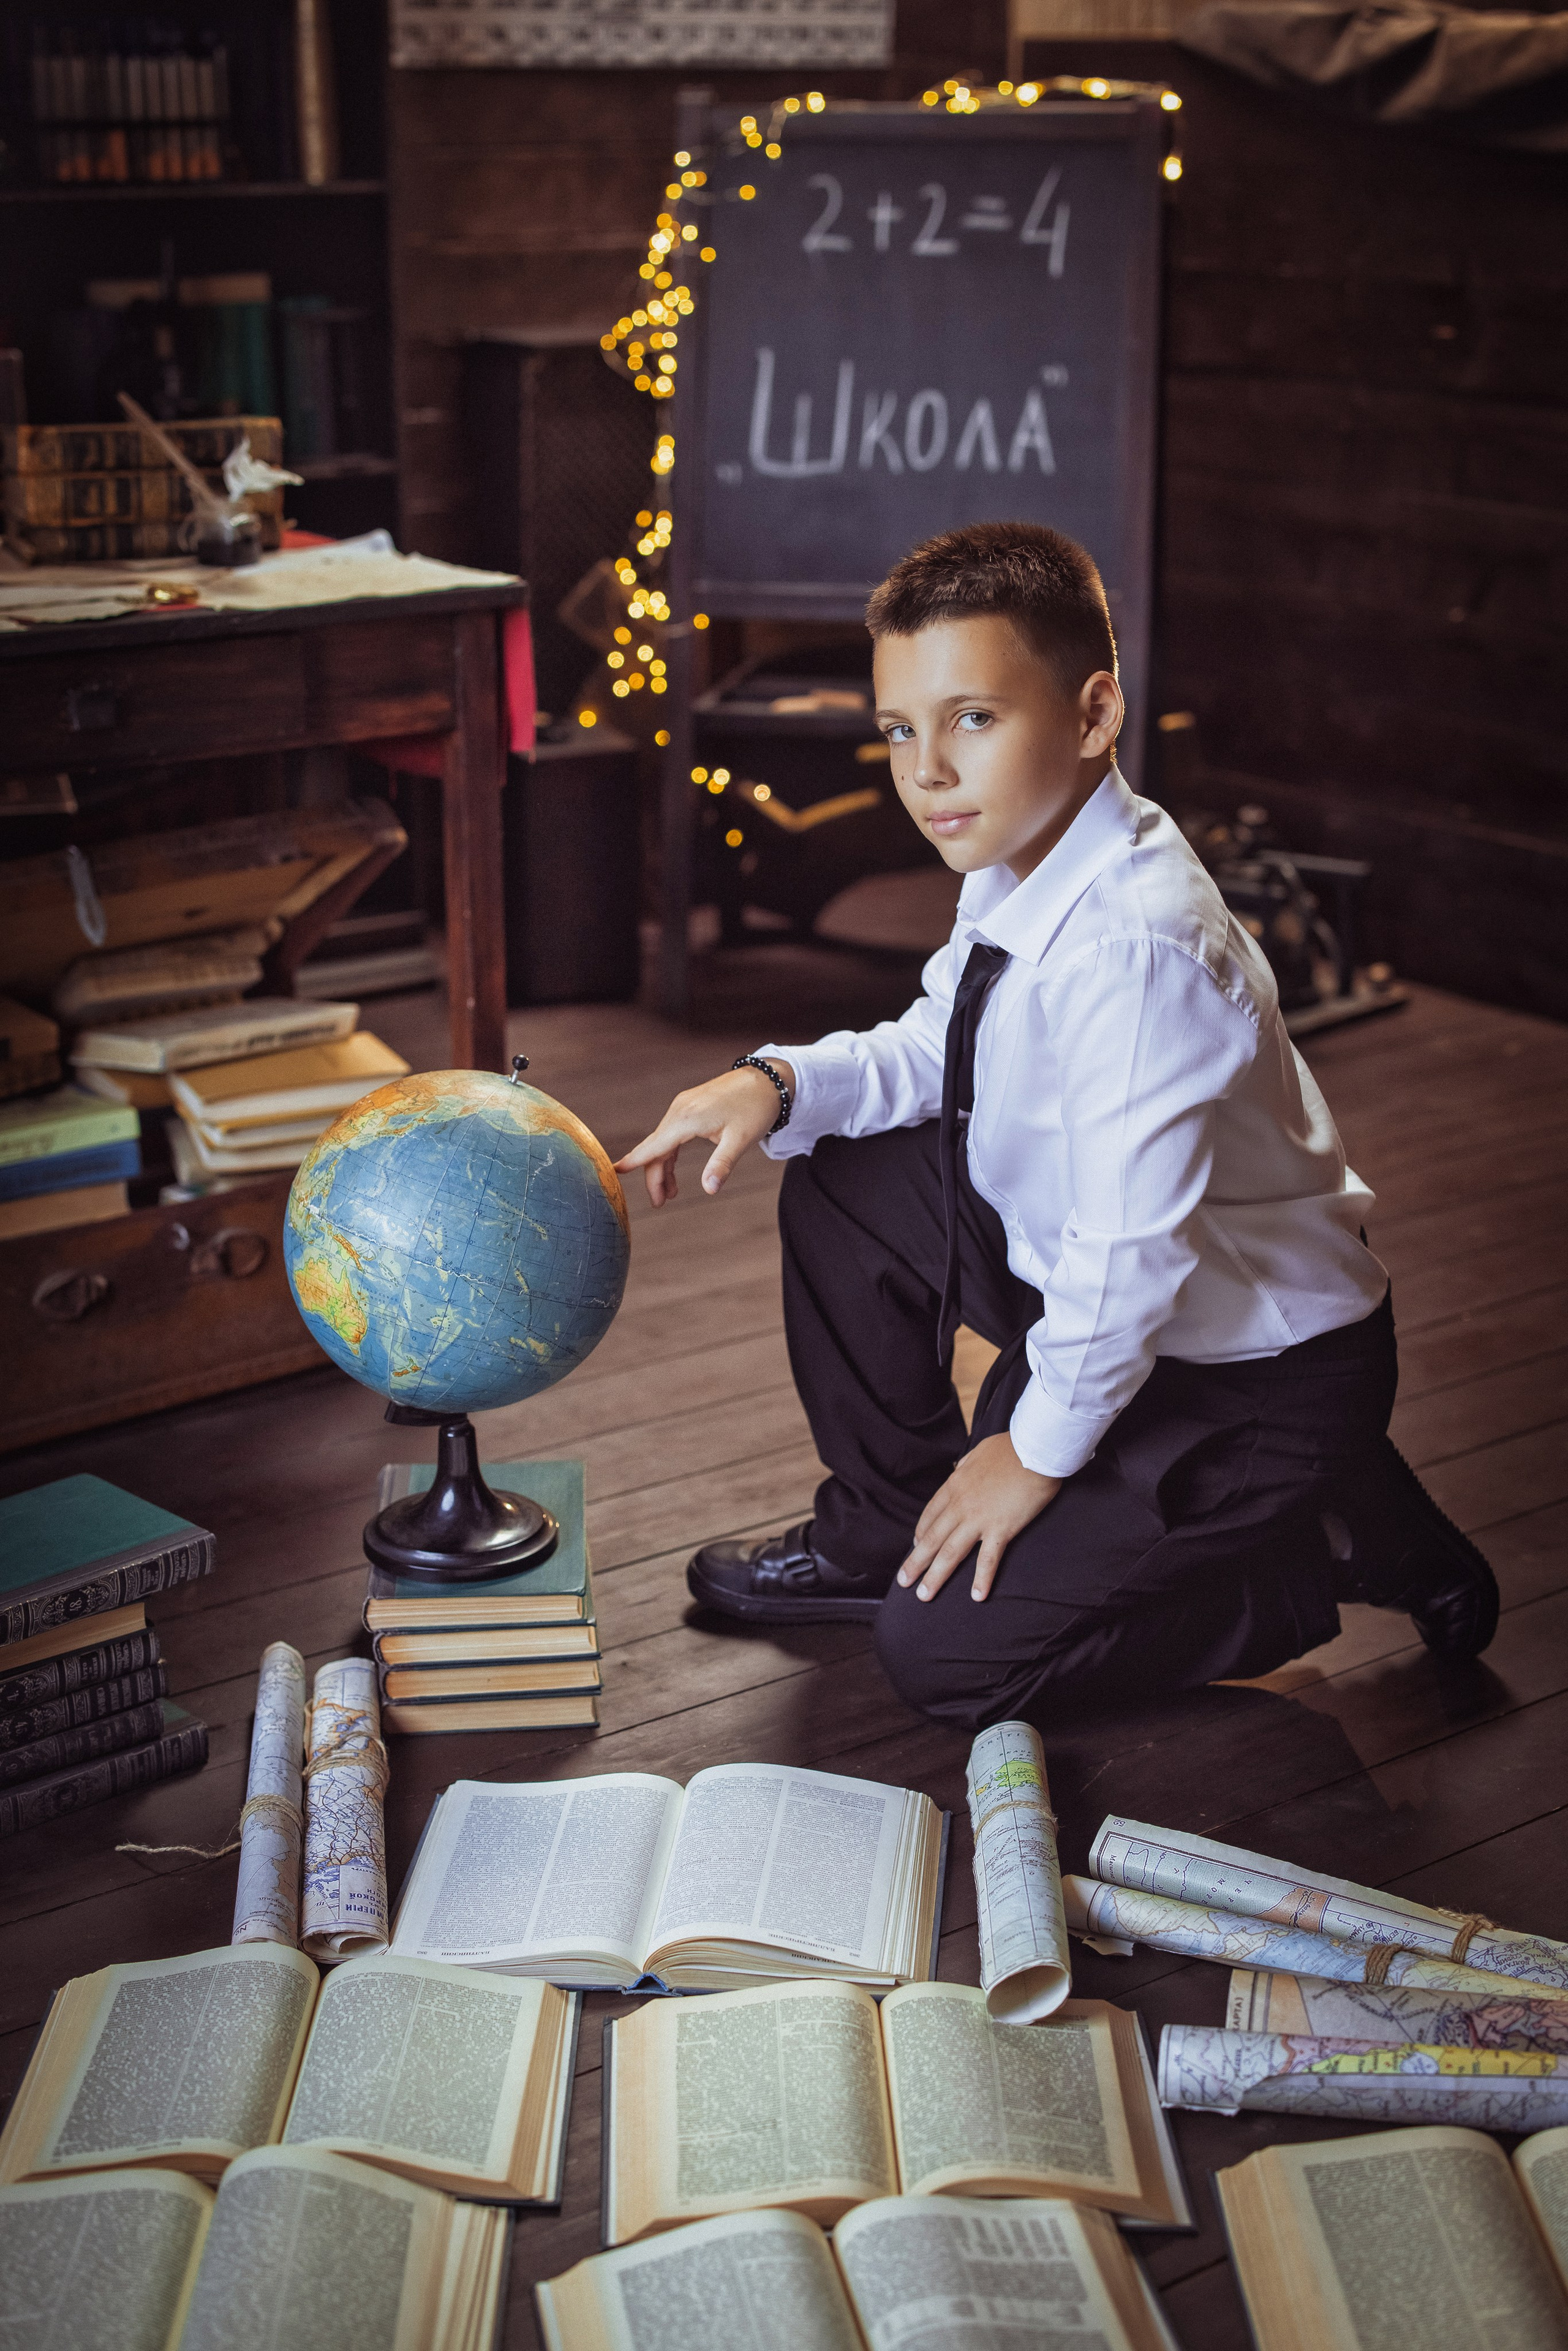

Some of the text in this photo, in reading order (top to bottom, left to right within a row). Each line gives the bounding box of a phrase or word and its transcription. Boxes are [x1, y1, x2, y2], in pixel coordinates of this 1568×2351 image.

[1113, 1819, 1126, 1827] 52
[349, 1893, 386, 1909] ИРСКОЙ
[1221, 1879, 1253, 1911] ЧЕРН
